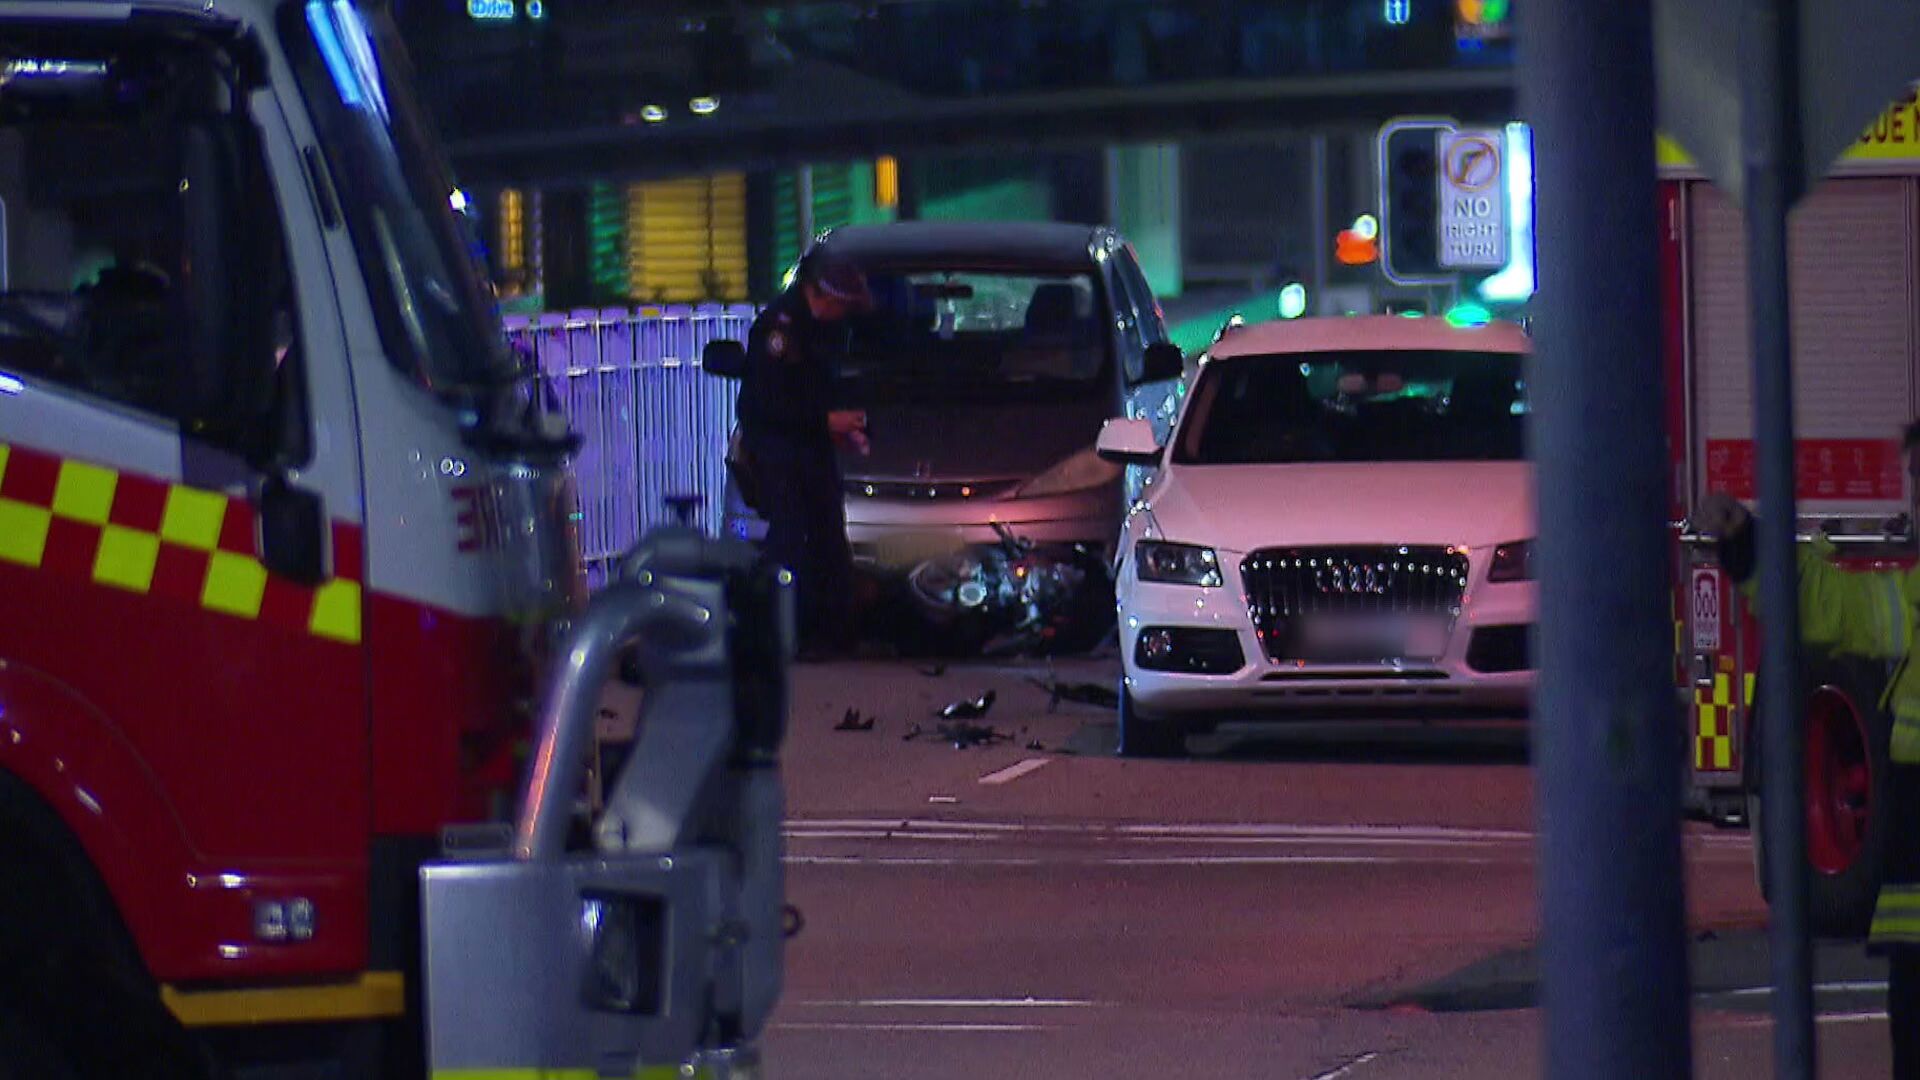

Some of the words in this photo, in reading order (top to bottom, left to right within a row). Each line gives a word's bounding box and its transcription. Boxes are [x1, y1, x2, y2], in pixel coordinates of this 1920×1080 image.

[1454, 199, 1491, 218] NO
[1447, 224, 1497, 237] RIGHT
[1451, 243, 1497, 256] TURN
